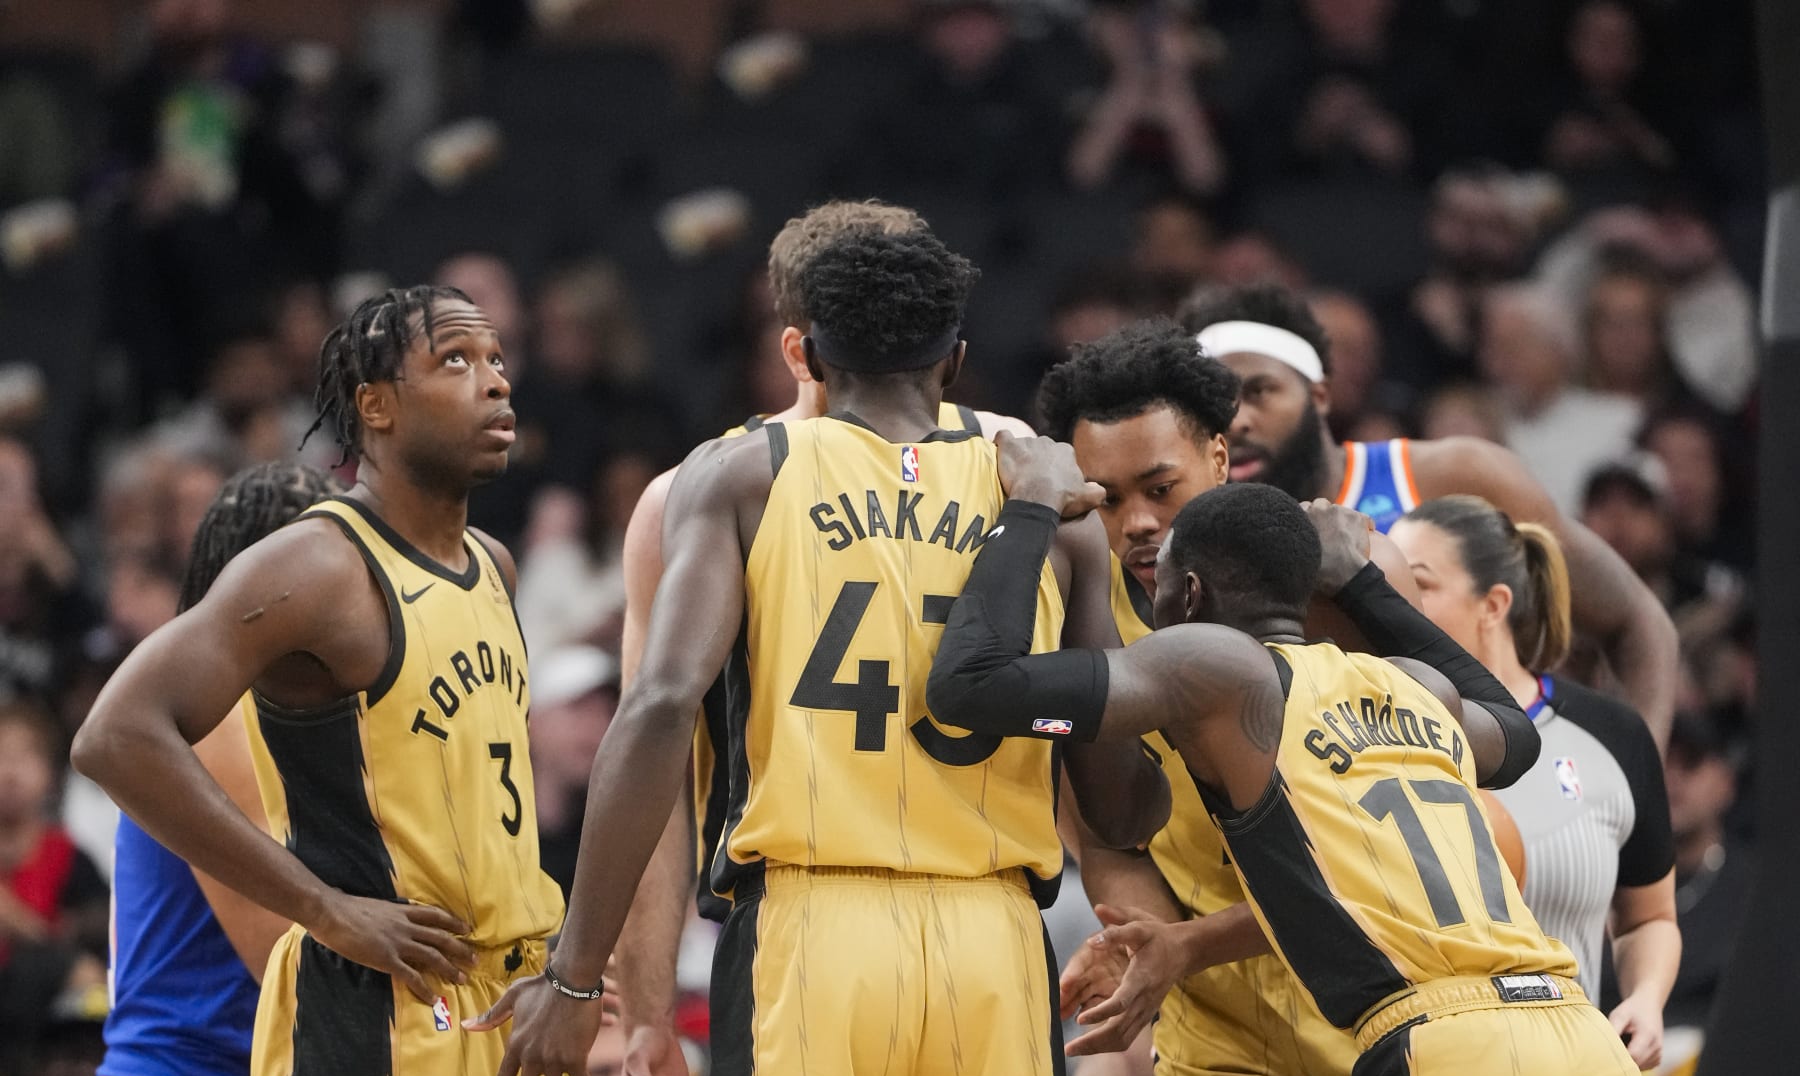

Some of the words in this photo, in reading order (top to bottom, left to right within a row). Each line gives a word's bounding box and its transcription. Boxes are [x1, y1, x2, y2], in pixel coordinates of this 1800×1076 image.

[411, 640, 531, 742] TORONT
[488, 742, 523, 837] 3
[1357, 777, 1513, 928] 17
